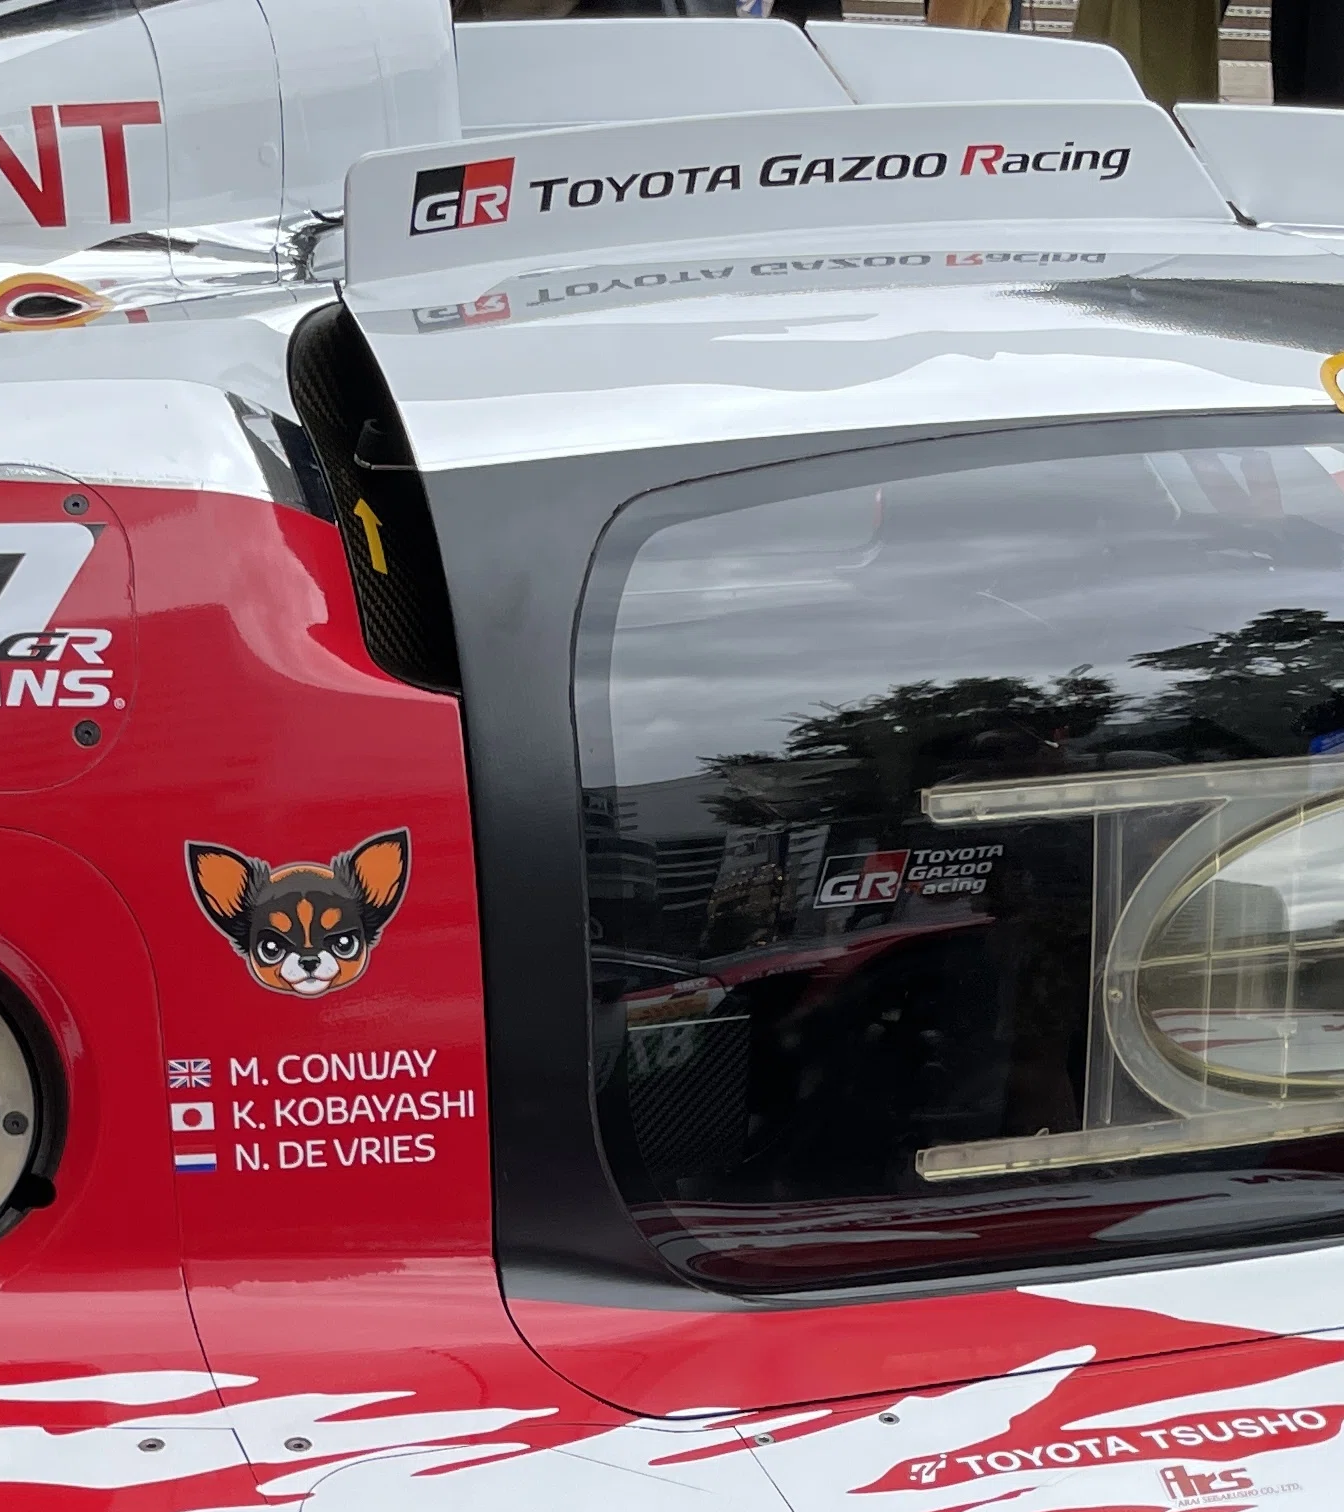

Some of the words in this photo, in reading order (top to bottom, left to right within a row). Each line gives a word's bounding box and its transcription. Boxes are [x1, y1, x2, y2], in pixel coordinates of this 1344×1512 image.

[413, 183, 508, 234] GR
[529, 166, 742, 212] TOYOTA
[759, 150, 950, 187] GAZOO
[960, 140, 1132, 183] Racing
[908, 861, 993, 881] GAZOO
[913, 845, 1004, 865] TOYOTA
[820, 870, 899, 903] GR
[229, 1057, 269, 1087] M.
[277, 1049, 437, 1085] CONWAY
[232, 1100, 266, 1131] K.
[274, 1090, 475, 1128] KOBAYASHI
[234, 1143, 270, 1172] N.
[279, 1140, 327, 1169] DE
[333, 1134, 436, 1166] VRIES
[956, 1427, 1139, 1475] TOYOTA
[1140, 1410, 1328, 1453] TSUSHO
